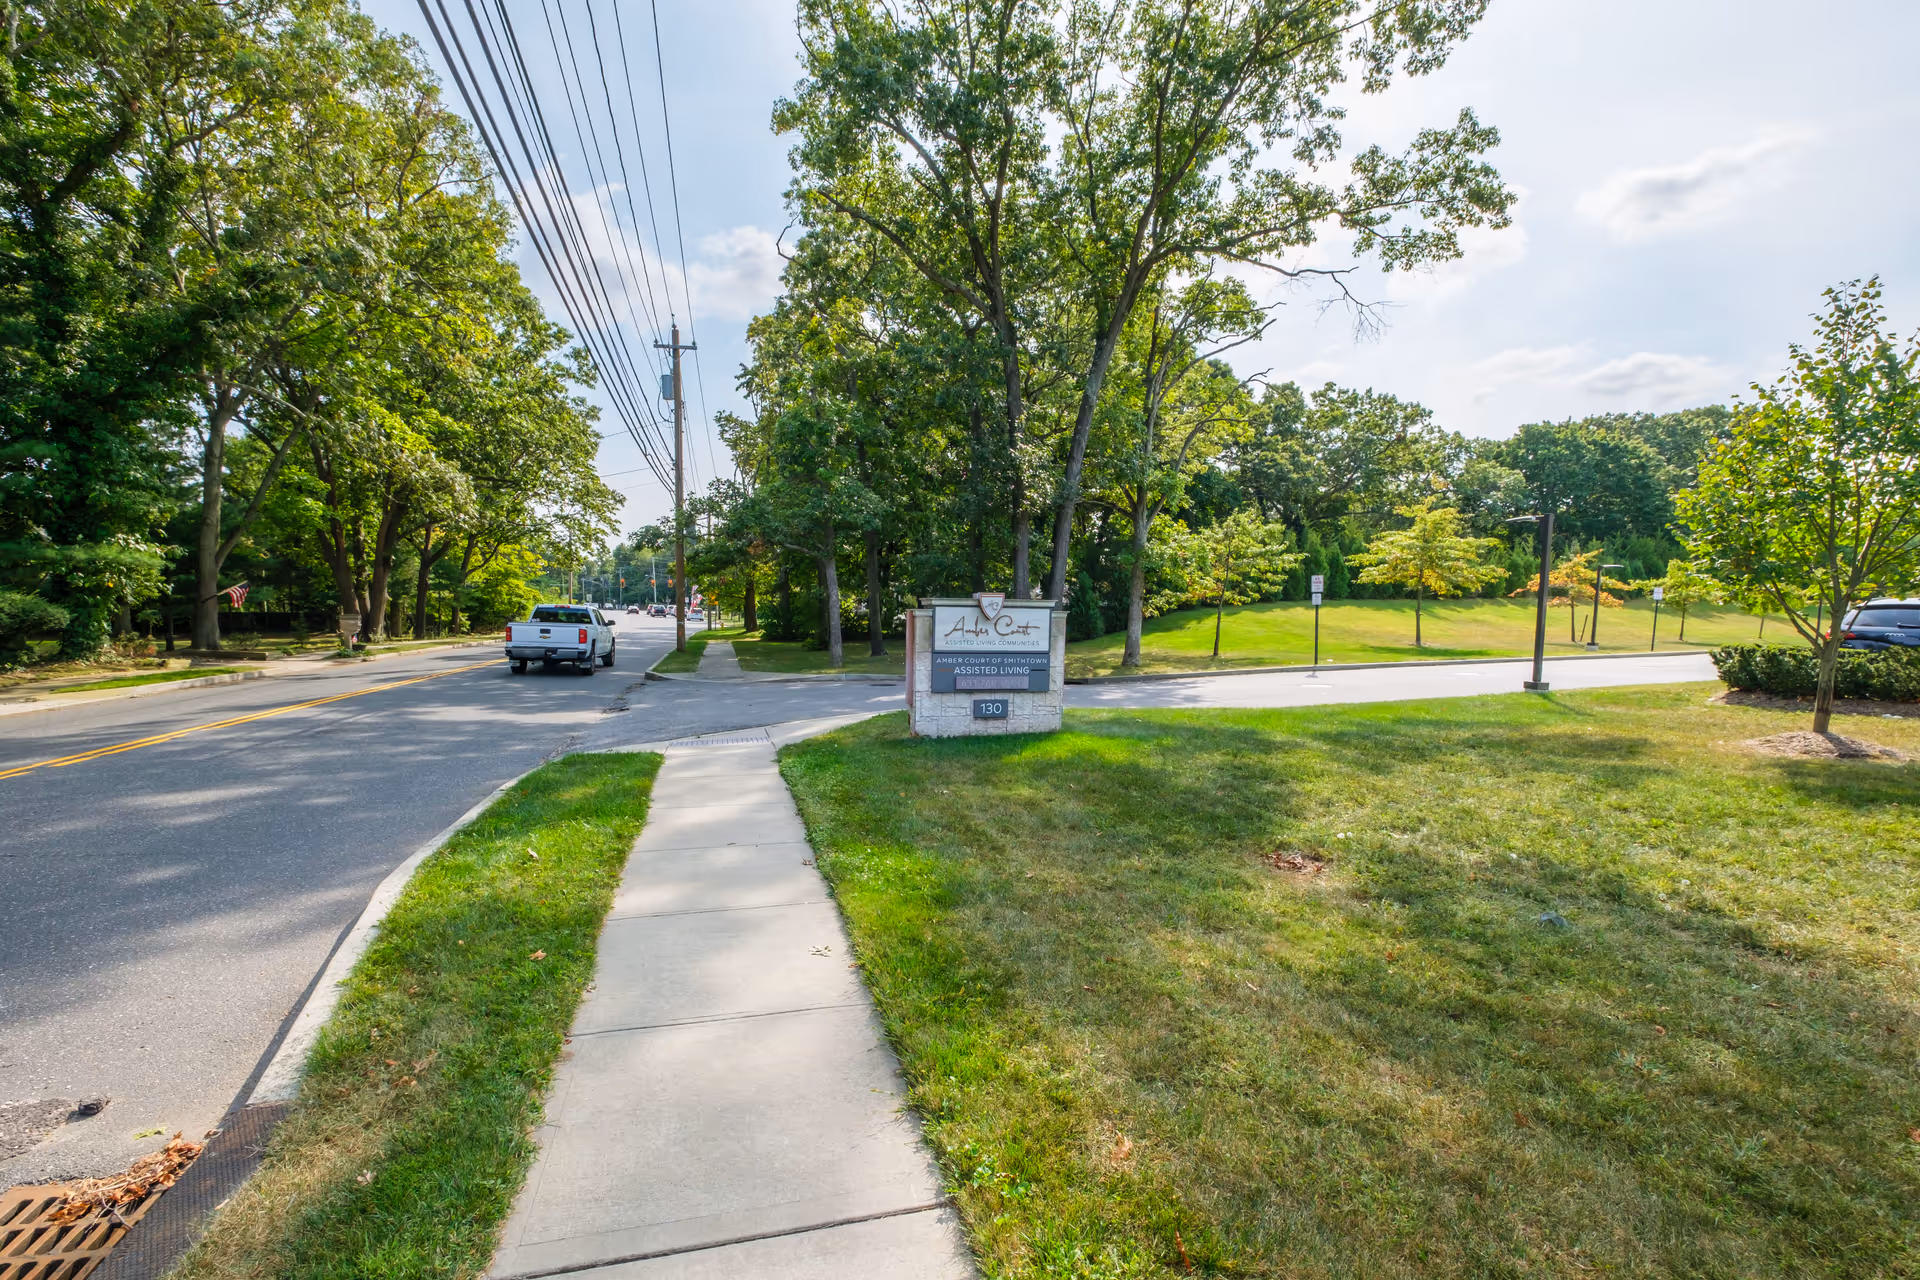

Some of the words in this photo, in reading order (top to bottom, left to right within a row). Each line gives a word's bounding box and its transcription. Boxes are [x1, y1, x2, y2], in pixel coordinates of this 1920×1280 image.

[944, 616, 989, 637] Amber
[994, 615, 1040, 636] Court
[953, 666, 998, 674] ASSISTED
[1000, 667, 1030, 675] LIVING
[980, 703, 1002, 714] 130
